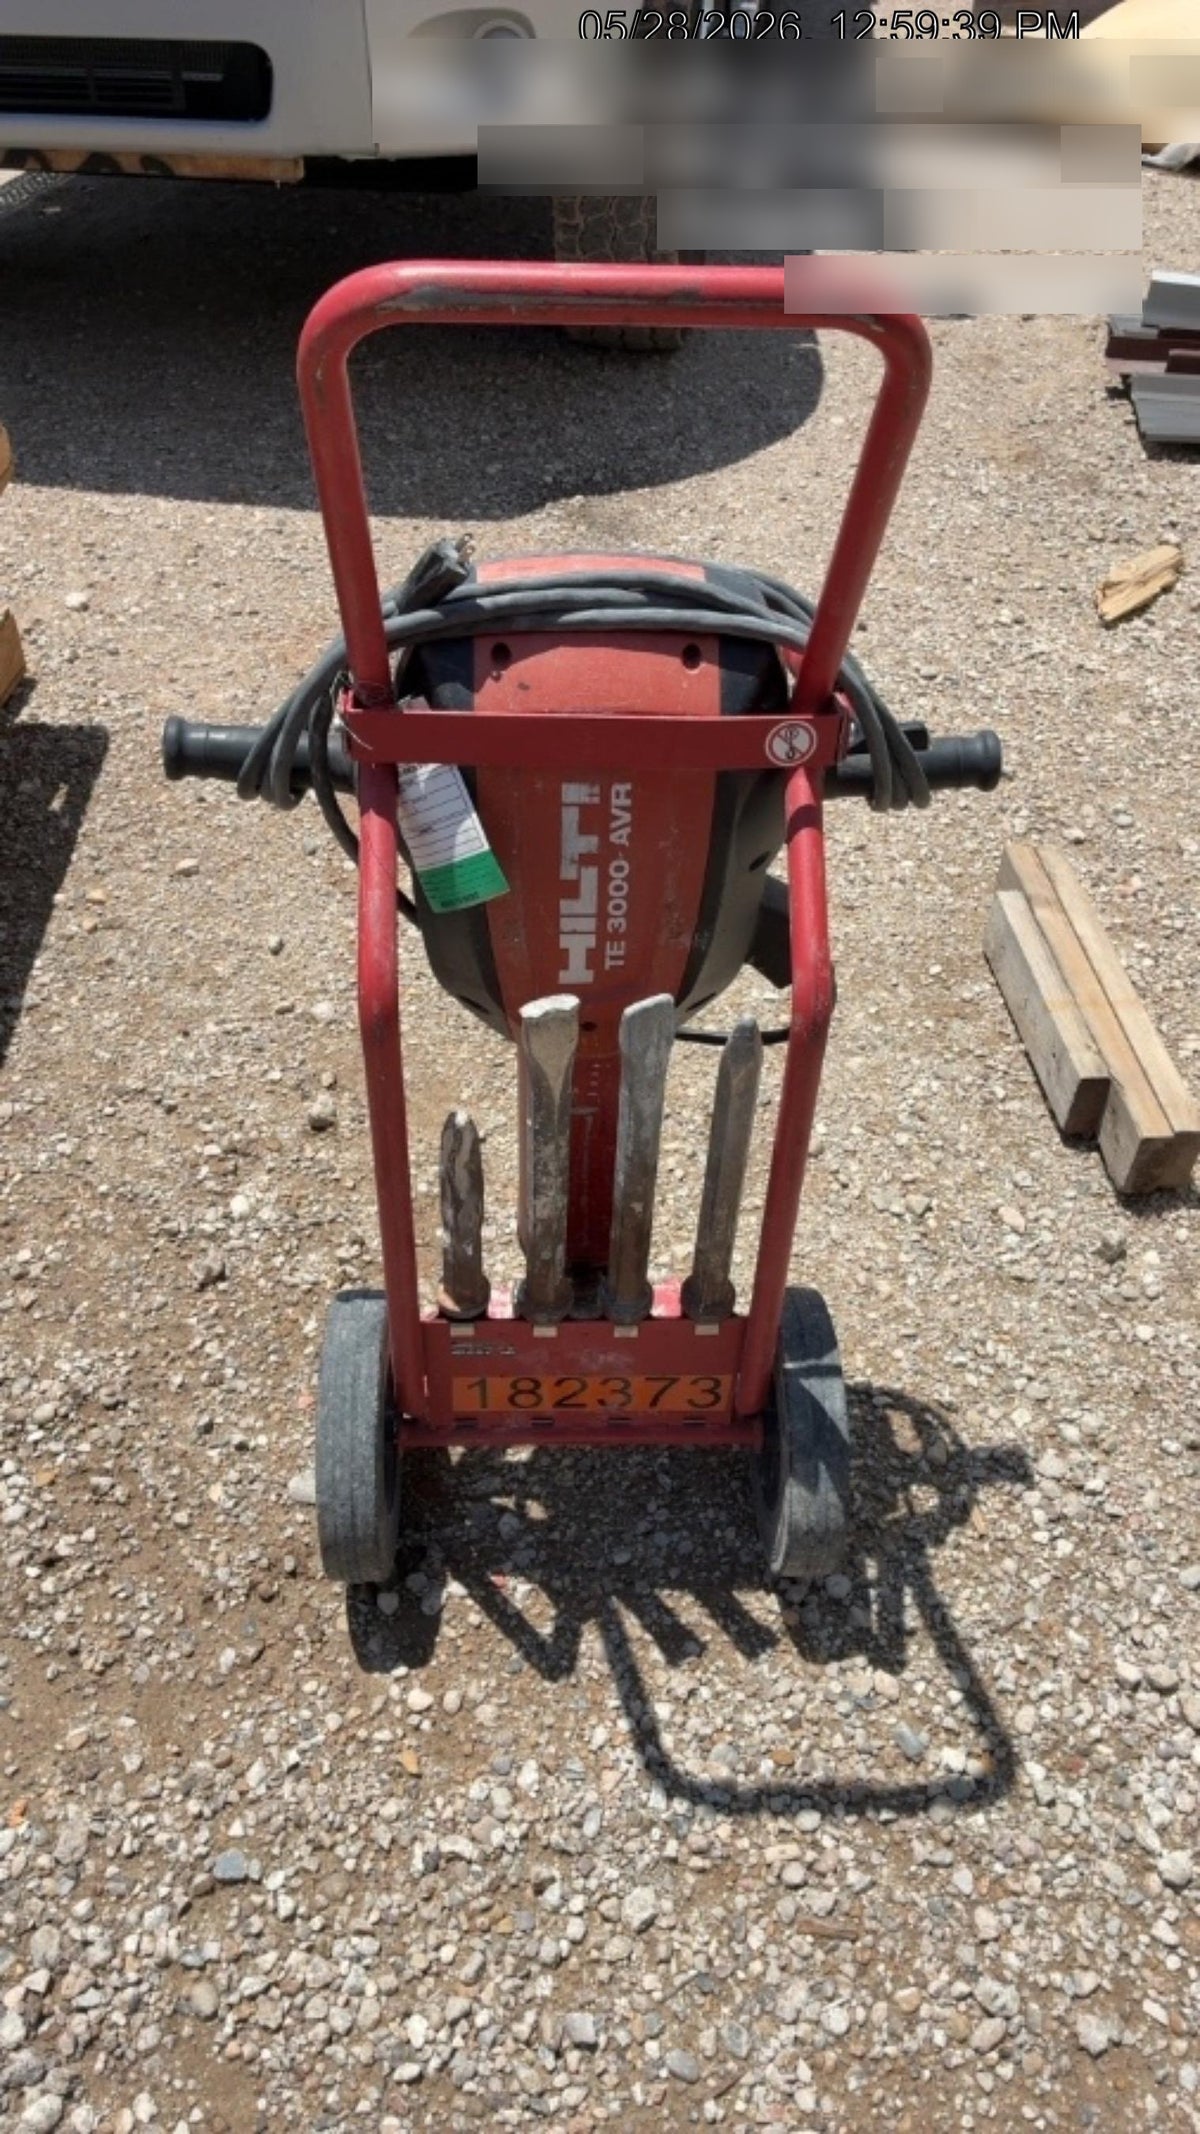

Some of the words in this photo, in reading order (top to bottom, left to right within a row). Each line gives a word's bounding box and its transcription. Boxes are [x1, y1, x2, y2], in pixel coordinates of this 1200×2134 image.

[558, 782, 600, 985] HILTI
[605, 940, 626, 970] TE
[466, 1376, 723, 1409] 182373
